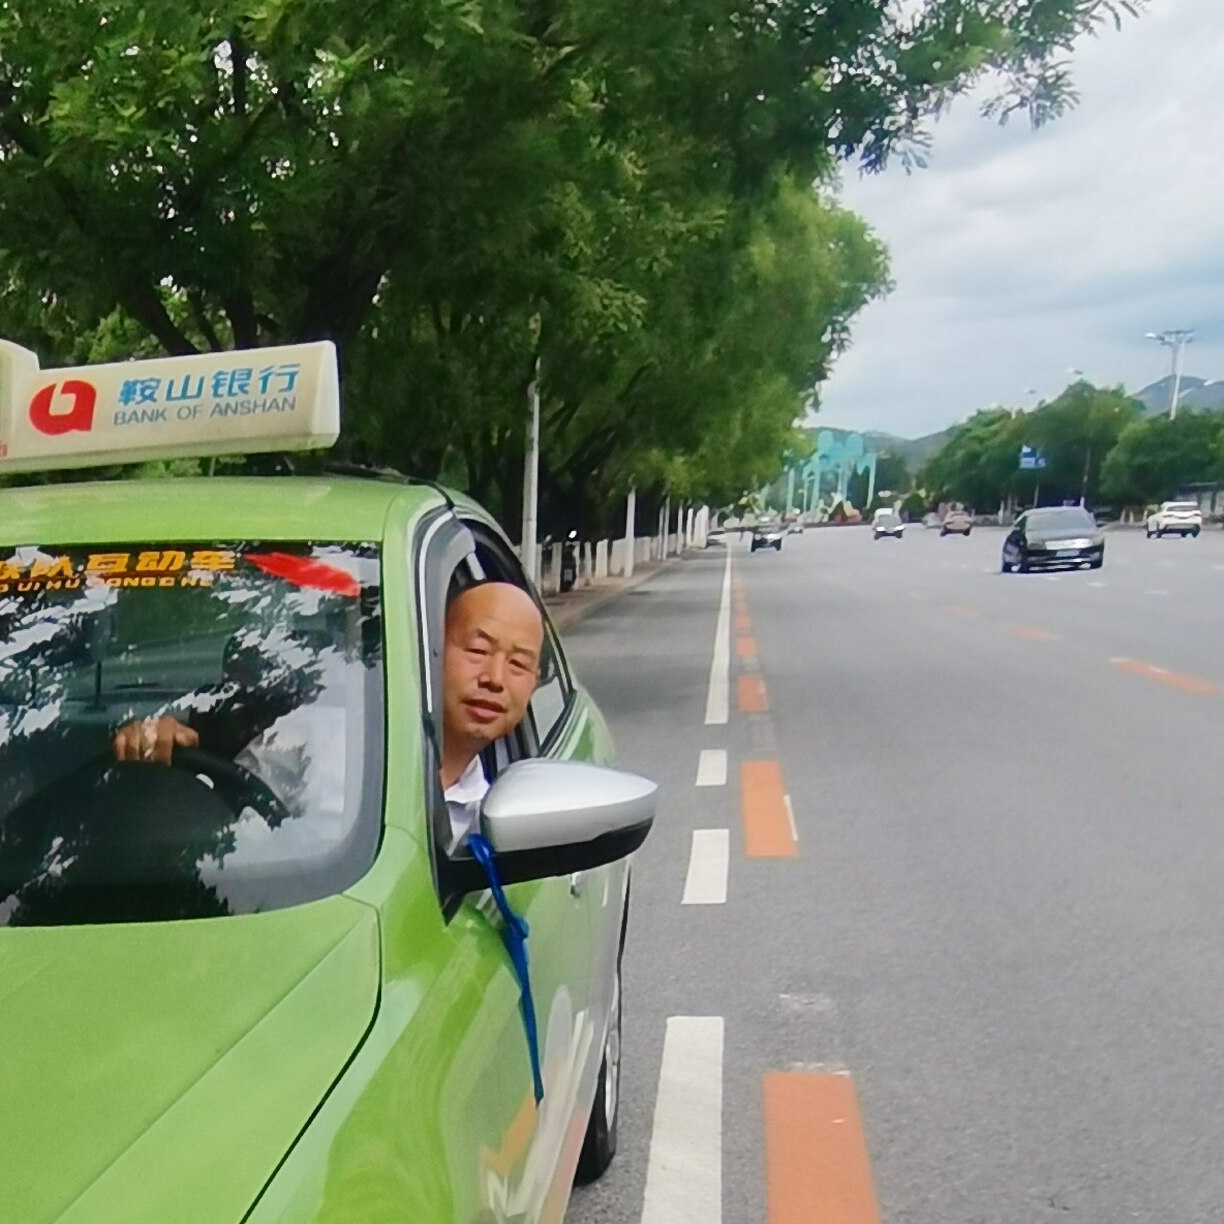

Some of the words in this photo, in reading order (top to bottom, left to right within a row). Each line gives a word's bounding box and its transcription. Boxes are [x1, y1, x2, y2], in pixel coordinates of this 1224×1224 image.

[118, 363, 301, 407] 鞍山银行
[114, 408, 167, 427] BANK
[177, 404, 203, 421] OF
[210, 396, 296, 418] ANSHAN
